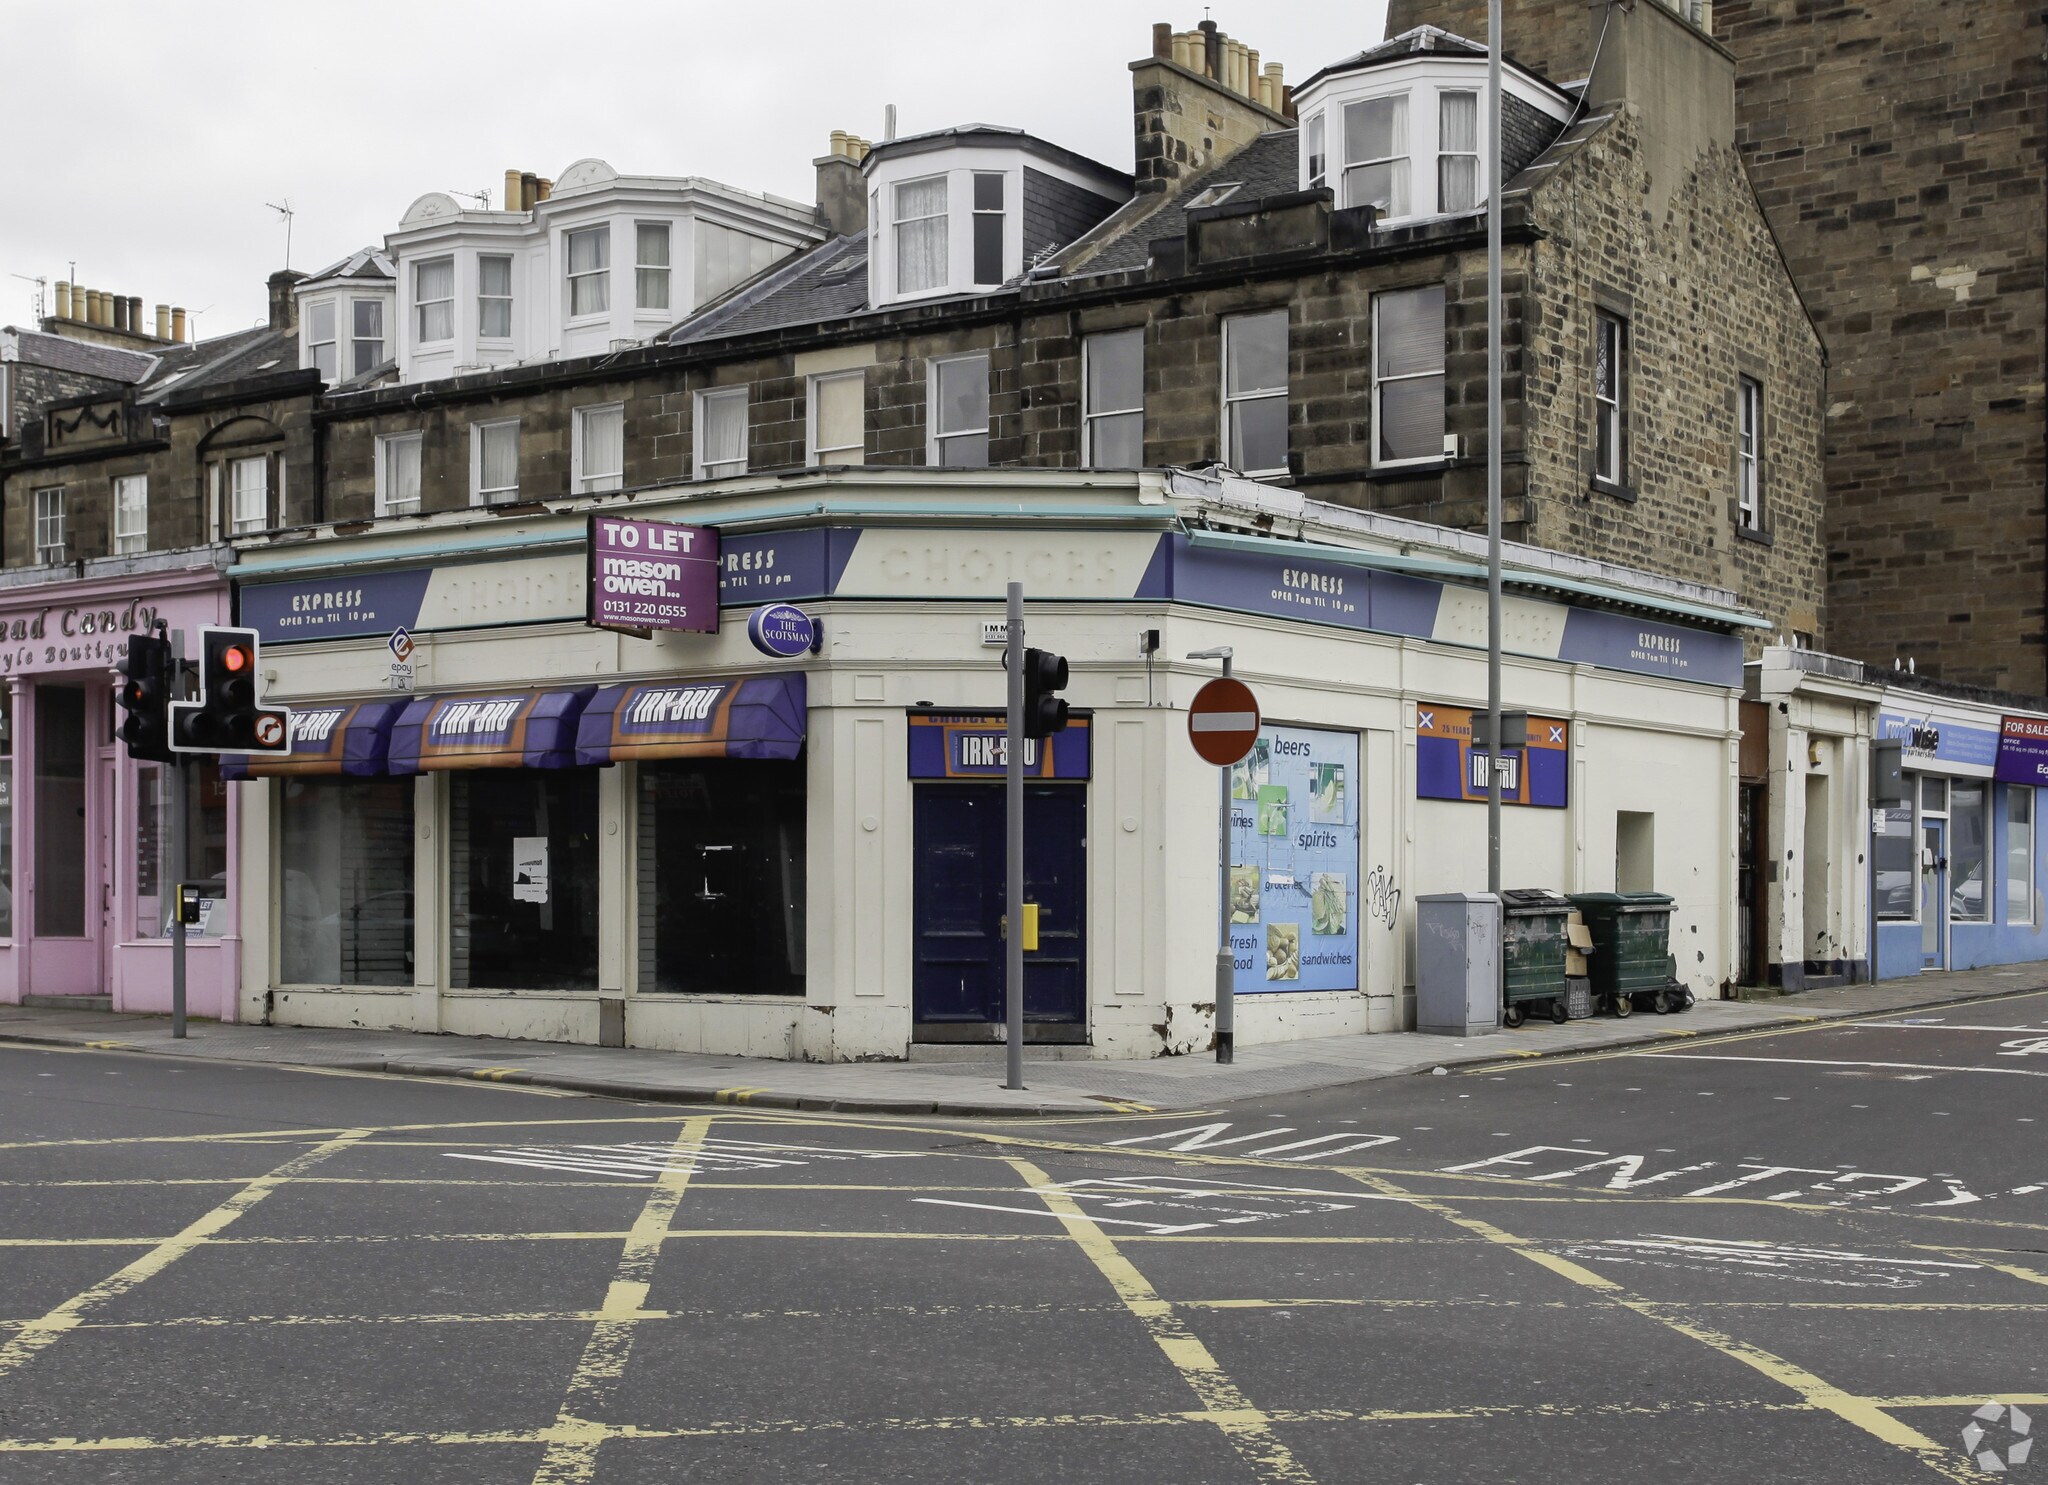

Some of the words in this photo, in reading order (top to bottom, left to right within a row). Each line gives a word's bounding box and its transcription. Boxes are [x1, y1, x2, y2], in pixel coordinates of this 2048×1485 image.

[603, 523, 639, 548] TO
[648, 528, 695, 553] LET
[603, 558, 681, 581] mason
[720, 550, 774, 572] RESS
[732, 576, 747, 587] TIL
[758, 574, 771, 585] 10
[776, 574, 792, 585] pm
[1283, 569, 1343, 595] EXPRESS
[292, 589, 362, 612] EXPRESS
[603, 600, 630, 613] 0131
[634, 602, 656, 615] 220
[658, 604, 687, 617] 0555
[1271, 589, 1292, 602] OPEN
[1295, 593, 1311, 605] 7am
[1314, 596, 1326, 607] TIL
[1332, 600, 1340, 610] 10
[1343, 603, 1355, 613] pm
[60, 598, 157, 638] Candy
[280, 616, 302, 626] OPEN
[306, 615, 324, 625] 7am
[327, 613, 340, 622] TIL
[348, 611, 358, 620] 10
[362, 611, 375, 622] pm
[603, 614, 671, 625] www.masonowen.com
[780, 620, 797, 632] THE
[765, 629, 811, 643] SCOTSMAN
[1638, 632, 1680, 653] EXPRESS
[0, 647, 33, 672] yle
[45, 640, 129, 664] Boutiqu
[1630, 650, 1645, 660] OPEN
[391, 663, 412, 675] epay
[2005, 721, 2024, 733] FOR
[2026, 723, 2048, 736] SALE
[1274, 734, 1311, 756] beers
[1907, 748, 1935, 760] partnership
[1231, 813, 1253, 828] ines
[1298, 831, 1337, 851] spirits
[1230, 934, 1258, 949] fresh
[1233, 955, 1253, 970] ood
[1302, 952, 1352, 966] sandwiches
[1102, 1122, 1401, 1161] NO
[1433, 1145, 2046, 1209] ENTRY
